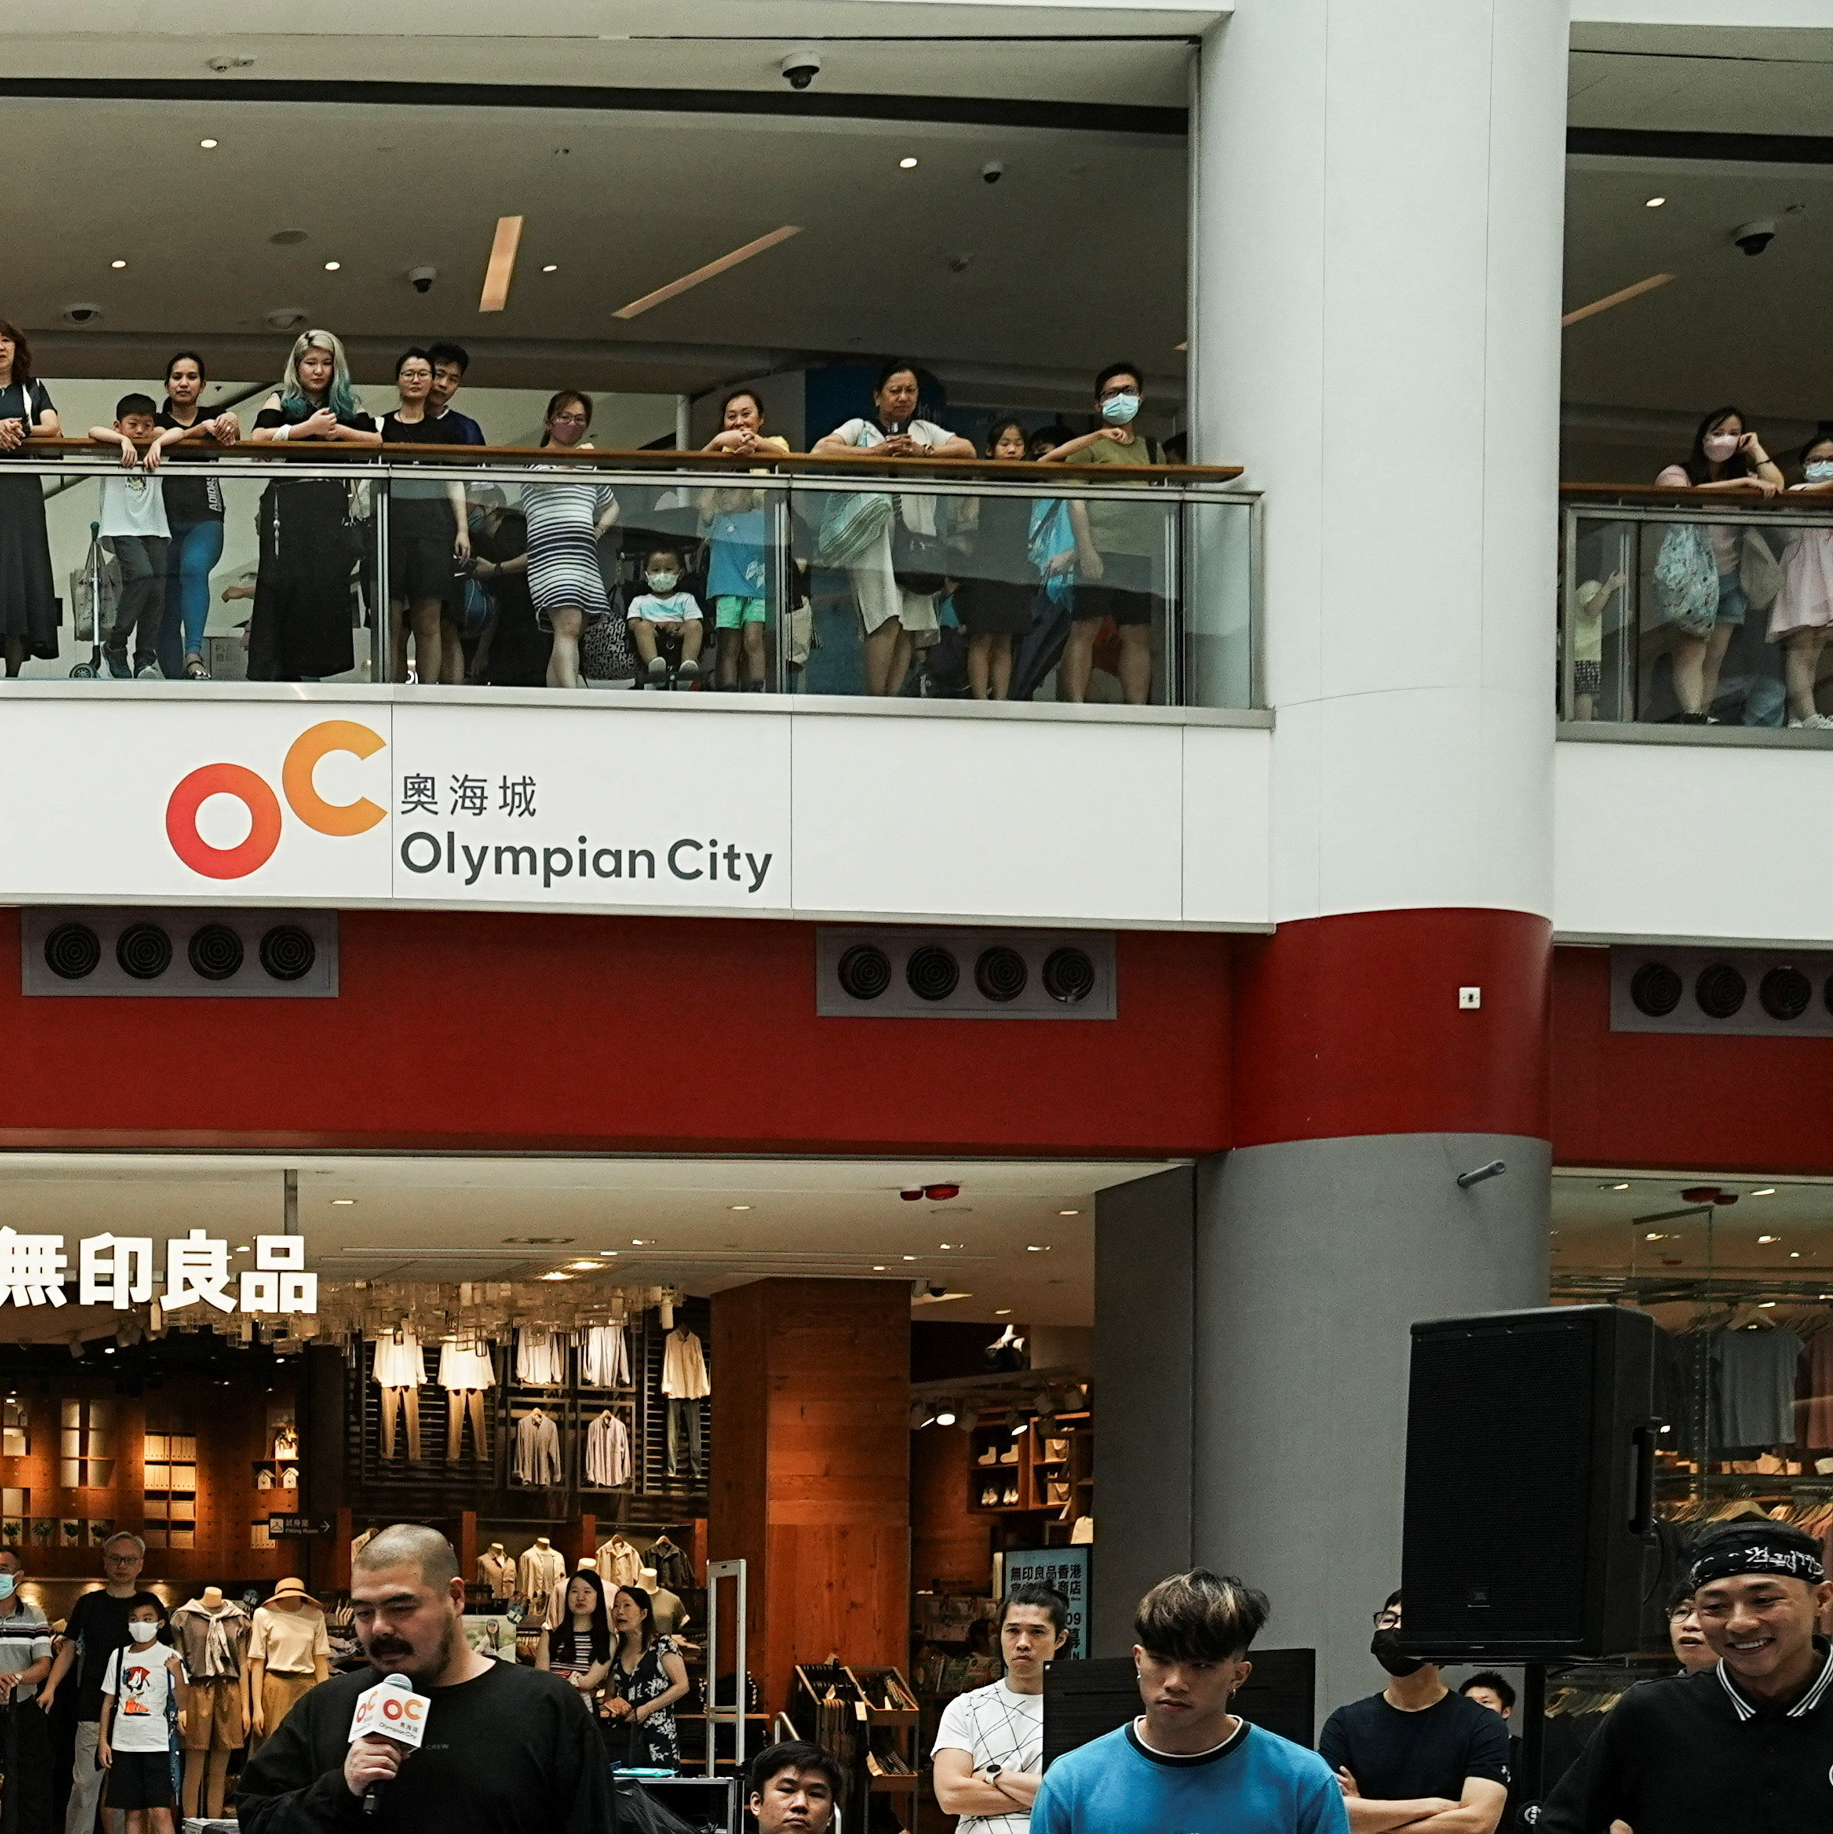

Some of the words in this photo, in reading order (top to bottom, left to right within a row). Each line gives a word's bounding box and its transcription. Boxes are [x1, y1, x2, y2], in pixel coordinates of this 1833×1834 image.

[165, 719, 388, 880] OC
[400, 773, 538, 818] 奧海城
[400, 831, 656, 888] Olympian
[667, 837, 773, 893] City
[1010, 1564, 1081, 1581] 無印良品香港
[383, 1699, 425, 1720] OC
